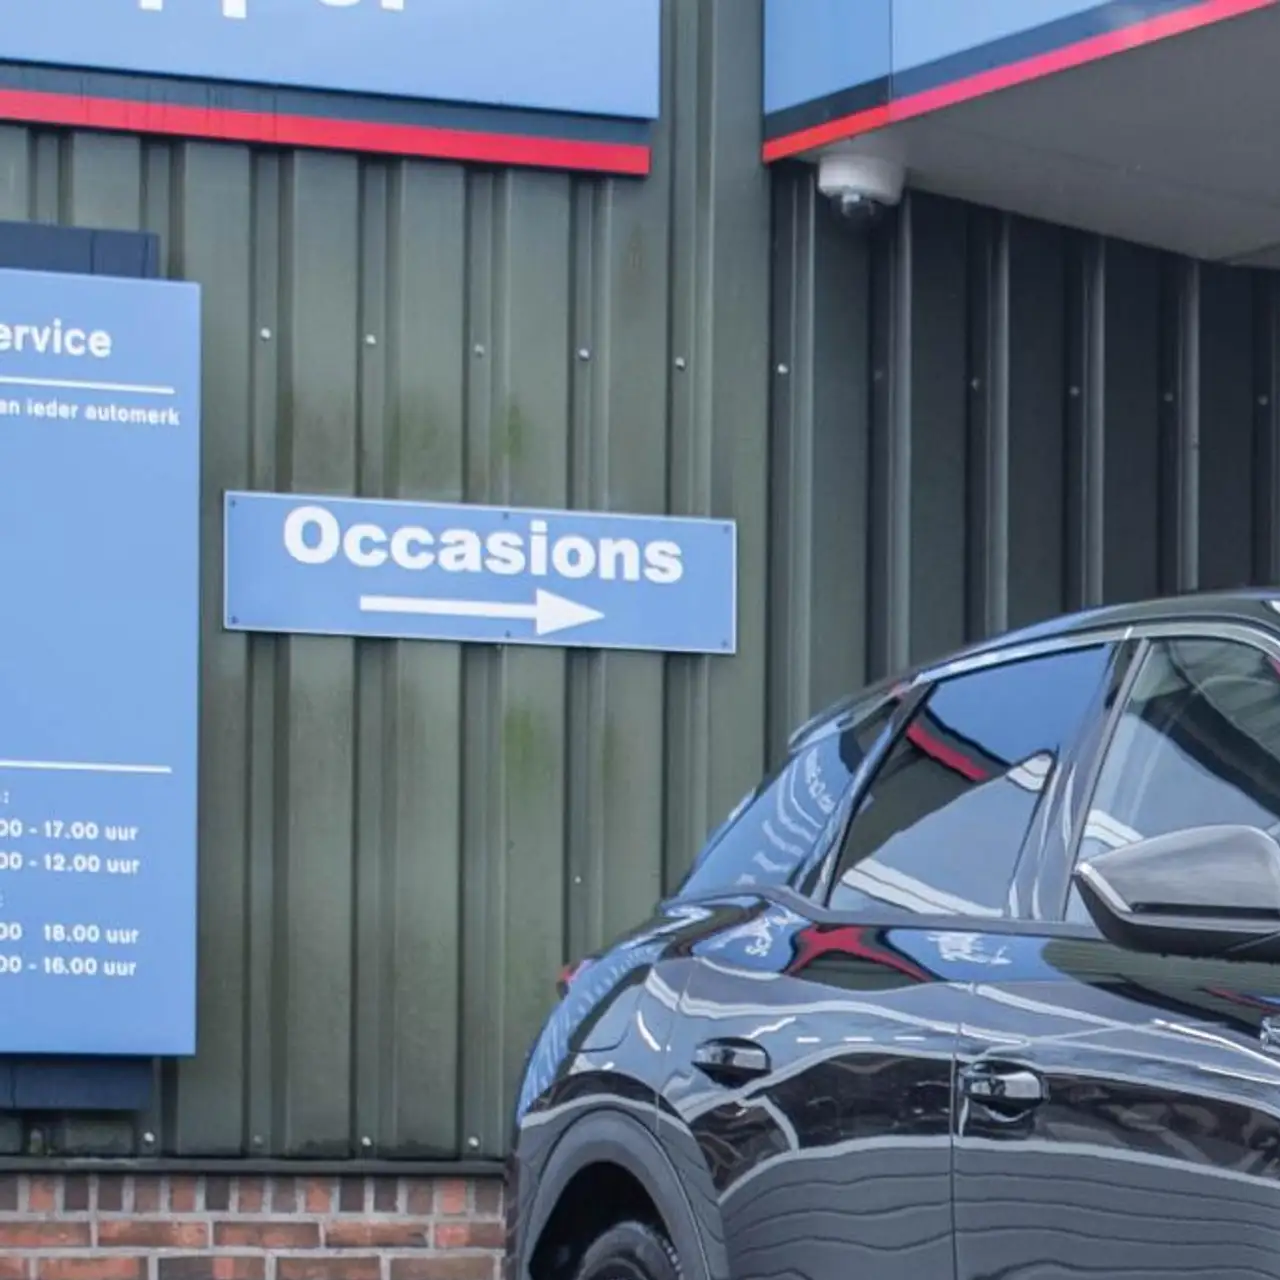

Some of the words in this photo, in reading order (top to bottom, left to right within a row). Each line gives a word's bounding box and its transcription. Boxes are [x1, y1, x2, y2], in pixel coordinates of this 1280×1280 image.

[85, 403, 180, 426] automerk
[283, 505, 684, 584] Occasions
[44, 820, 99, 840] 17.00
[104, 825, 139, 841] uur
[44, 853, 100, 873] 12.00
[106, 858, 140, 874] uur
[44, 923, 100, 943] 18.00
[105, 928, 140, 944] uur
[44, 956, 98, 976] 16.00
[103, 960, 137, 976] uur
